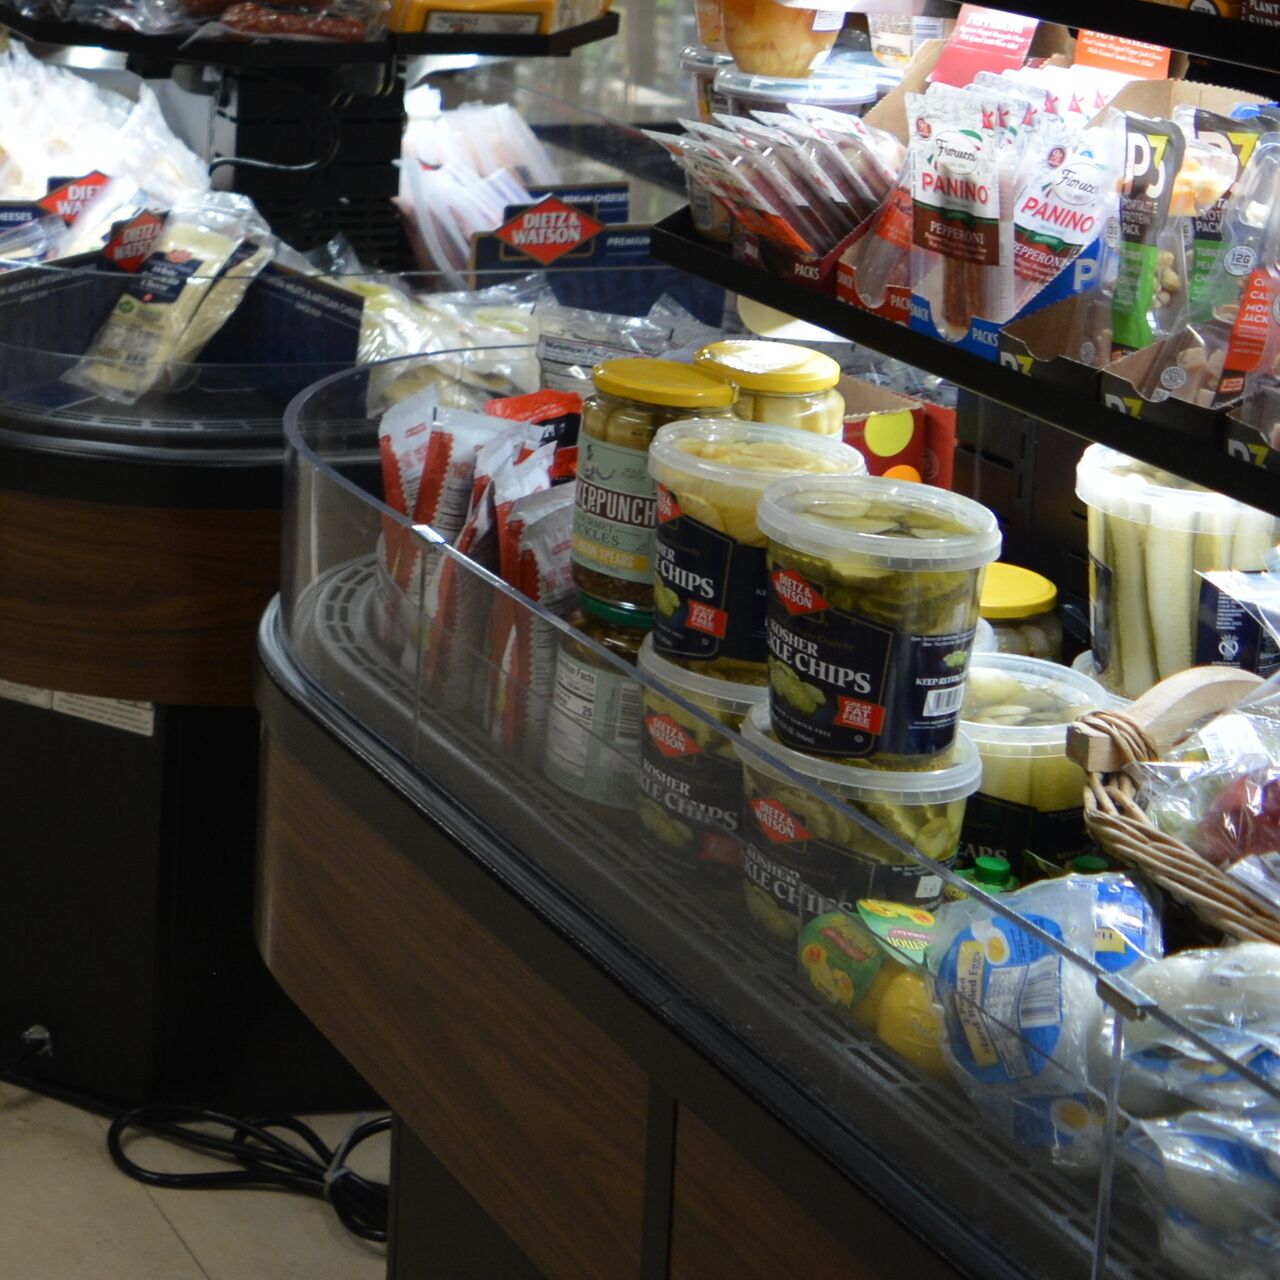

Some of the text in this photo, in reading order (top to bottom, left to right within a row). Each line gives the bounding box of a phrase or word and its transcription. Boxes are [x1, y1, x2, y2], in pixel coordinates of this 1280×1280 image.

[920, 171, 989, 207] PANINO
[522, 211, 582, 230] DIETZ &
[1020, 196, 1095, 234] PANINO
[512, 224, 583, 246] WATSON
[606, 235, 652, 248] PREMIUM
[929, 220, 986, 246] PEPPERONI
[1230, 253, 1251, 265] 12G
[793, 263, 820, 281] PACKS
[890, 294, 912, 310] PACK
[971, 327, 1000, 347] PACKS
[577, 481, 657, 528] KERPUNCH
[660, 559, 715, 600] CHIPS
[778, 572, 805, 596] DIETZ
[775, 581, 814, 610] WATSON
[770, 618, 819, 659] KOSHER
[794, 652, 873, 695] CHIPS
[915, 676, 939, 687] KEEP
[844, 699, 874, 710] GREAT
[844, 706, 873, 719] FAT
[652, 716, 676, 738] DIETZ
[648, 726, 686, 754] WATSON
[642, 757, 691, 797] KOSHER
[758, 800, 786, 823] DIETZ
[755, 808, 797, 839] WATSON
